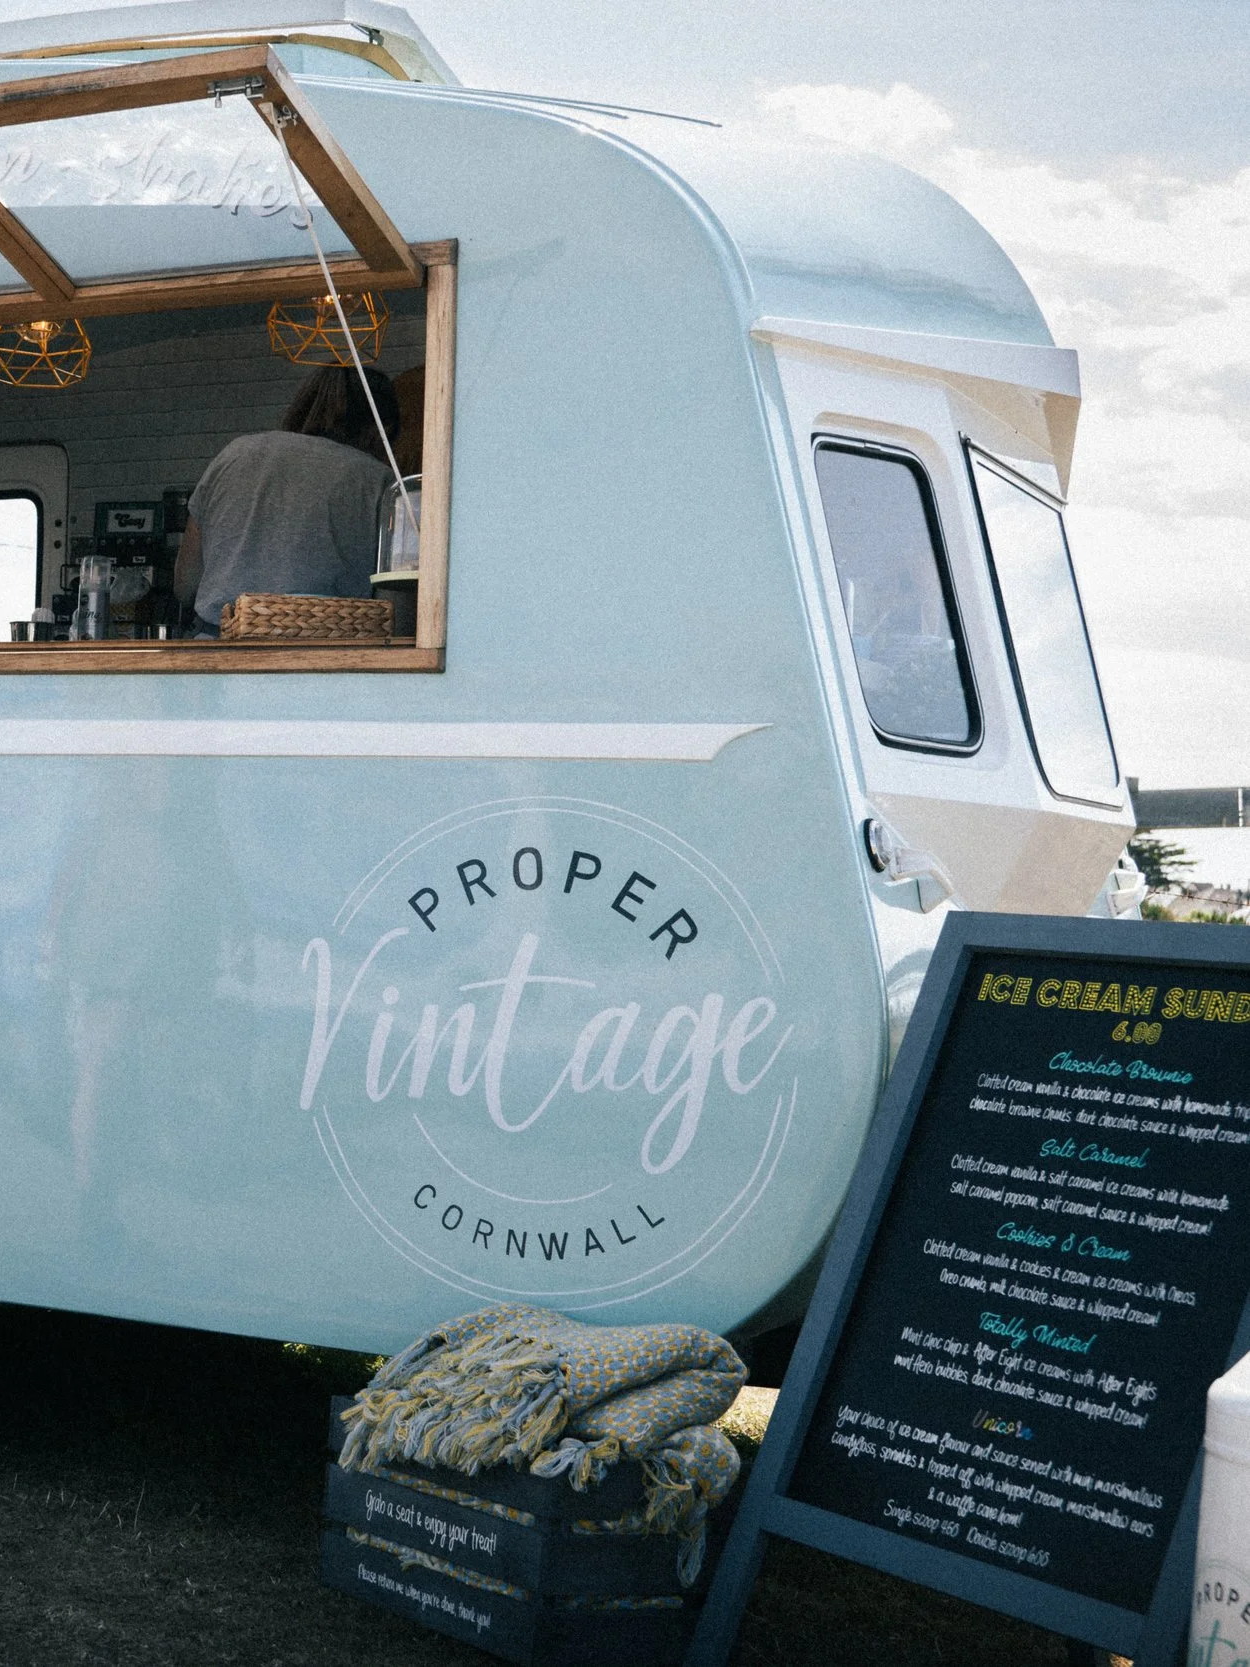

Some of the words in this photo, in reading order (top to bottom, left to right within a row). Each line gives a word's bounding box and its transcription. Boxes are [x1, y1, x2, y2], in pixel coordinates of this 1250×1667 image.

[407, 846, 699, 960] PROPER
[978, 973, 1033, 1005] ICE
[1036, 978, 1157, 1016] CREAM
[300, 927, 794, 1175] Vintage
[1112, 1020, 1162, 1044] 6.00
[978, 1073, 1009, 1089] Clotted
[1007, 1079, 1033, 1092] cream
[1035, 1081, 1062, 1096] vanilla
[1071, 1084, 1111, 1103] chocolate
[1112, 1092, 1125, 1104] ice
[1126, 1094, 1160, 1109] creams
[1161, 1095, 1182, 1112] with
[1184, 1097, 1231, 1116] homemade
[1049, 1050, 1123, 1076] Chocolate
[1126, 1060, 1194, 1084] Brownie
[969, 1095, 1006, 1113] chocolate
[1008, 1098, 1042, 1118] brownie
[1075, 1108, 1097, 1125] dark
[1098, 1112, 1138, 1131] chocolate
[1140, 1120, 1168, 1133] sauce
[1169, 1123, 1176, 1135] &
[1178, 1124, 1220, 1143] whipped
[1039, 1137, 1077, 1157] Salt
[1078, 1143, 1150, 1168] Caramel
[950, 1180, 969, 1196] salt
[969, 1185, 1006, 1201] caramel
[1041, 1195, 1063, 1213] salt
[1061, 1200, 1101, 1219] caramel
[1099, 1207, 1127, 1222] sauce
[1128, 1211, 1136, 1224] &
[1137, 1213, 1179, 1232] whipped
[951, 1154, 983, 1172] Clotted
[982, 1161, 1009, 1175] cream
[1011, 1166, 1038, 1182] vanilla
[1038, 1170, 1046, 1182] &
[1048, 1170, 1068, 1187] salt
[1067, 1175, 1107, 1192] caramel
[1106, 1181, 1119, 1194] ice
[1120, 1183, 1156, 1200] creams
[1156, 1188, 1179, 1204] with
[1179, 1190, 1229, 1211] homemade
[413, 1183, 666, 1261] CORNWALL
[996, 1222, 1056, 1248] Cookies
[1078, 1236, 1131, 1260] Cream
[924, 1239, 956, 1259] Clotted
[954, 1247, 981, 1263] cream
[983, 1253, 1010, 1269] vanilla
[1010, 1258, 1018, 1271] &
[1019, 1260, 1052, 1278] cookies
[1052, 1267, 1061, 1280] &
[1061, 1269, 1090, 1286] cream
[1093, 1275, 1106, 1288] ice
[1108, 1278, 1143, 1296] creams
[1144, 1282, 1166, 1301] with
[940, 1268, 959, 1285] Oreo
[990, 1278, 1006, 1296] milk
[1007, 1280, 1048, 1305] chocolate
[1050, 1293, 1076, 1310] sauce
[1077, 1299, 1085, 1311] &
[1086, 1298, 1129, 1322] whipped
[901, 1326, 923, 1346] Mint
[922, 1332, 943, 1349] choc
[943, 1337, 962, 1357] chip
[961, 1343, 969, 1355] &
[973, 1341, 997, 1365] After
[998, 1348, 1023, 1375] Eight
[1023, 1358, 1037, 1372] ice
[1037, 1362, 1072, 1381] creams
[1073, 1369, 1094, 1387] with
[1097, 1372, 1125, 1394] After
[979, 1311, 1028, 1349] Totally
[1032, 1324, 1098, 1355] Minted
[894, 1354, 915, 1371] mint
[913, 1354, 933, 1374] Aero
[971, 1368, 994, 1390] dark
[993, 1375, 1035, 1400] chocolate
[1036, 1390, 1064, 1407] sauce
[1065, 1396, 1073, 1409] &
[1074, 1397, 1116, 1420] whipped
[972, 1409, 1033, 1440] Unicorn
[836, 1405, 861, 1428] Your
[861, 1411, 885, 1430] choice
[886, 1420, 900, 1440] of
[898, 1424, 912, 1438] ice
[912, 1428, 939, 1444] cream
[938, 1432, 971, 1454] flavour
[971, 1443, 993, 1460] and
[991, 1450, 1019, 1468] sauce
[1019, 1458, 1052, 1478] served
[1050, 1465, 1073, 1485] with
[1094, 1479, 1163, 1509] marshmallows
[880, 1446, 917, 1468] sprinkles
[918, 1456, 925, 1469] &
[927, 1456, 959, 1479] topped
[958, 1467, 975, 1490] off
[974, 1472, 994, 1491] with
[995, 1477, 1035, 1502] whipped
[1066, 1501, 1129, 1529] marshmallow
[1130, 1520, 1154, 1538] ears
[927, 1486, 935, 1500] &
[936, 1491, 945, 1503] a
[945, 1495, 976, 1517] waffle
[976, 1503, 998, 1521] cone
[365, 1489, 386, 1521] Grab
[387, 1502, 393, 1518] a
[395, 1504, 415, 1528] seat
[416, 1511, 422, 1526] &
[424, 1514, 447, 1548] enjoy
[448, 1524, 469, 1552] your
[471, 1525, 497, 1556] treat!
[883, 1499, 912, 1527] Single
[912, 1512, 940, 1533] scoop
[965, 1526, 998, 1551] Double
[998, 1540, 1028, 1564] scoop
[358, 1562, 376, 1584] Please
[405, 1584, 421, 1602] when
[458, 1601, 475, 1623] thank
